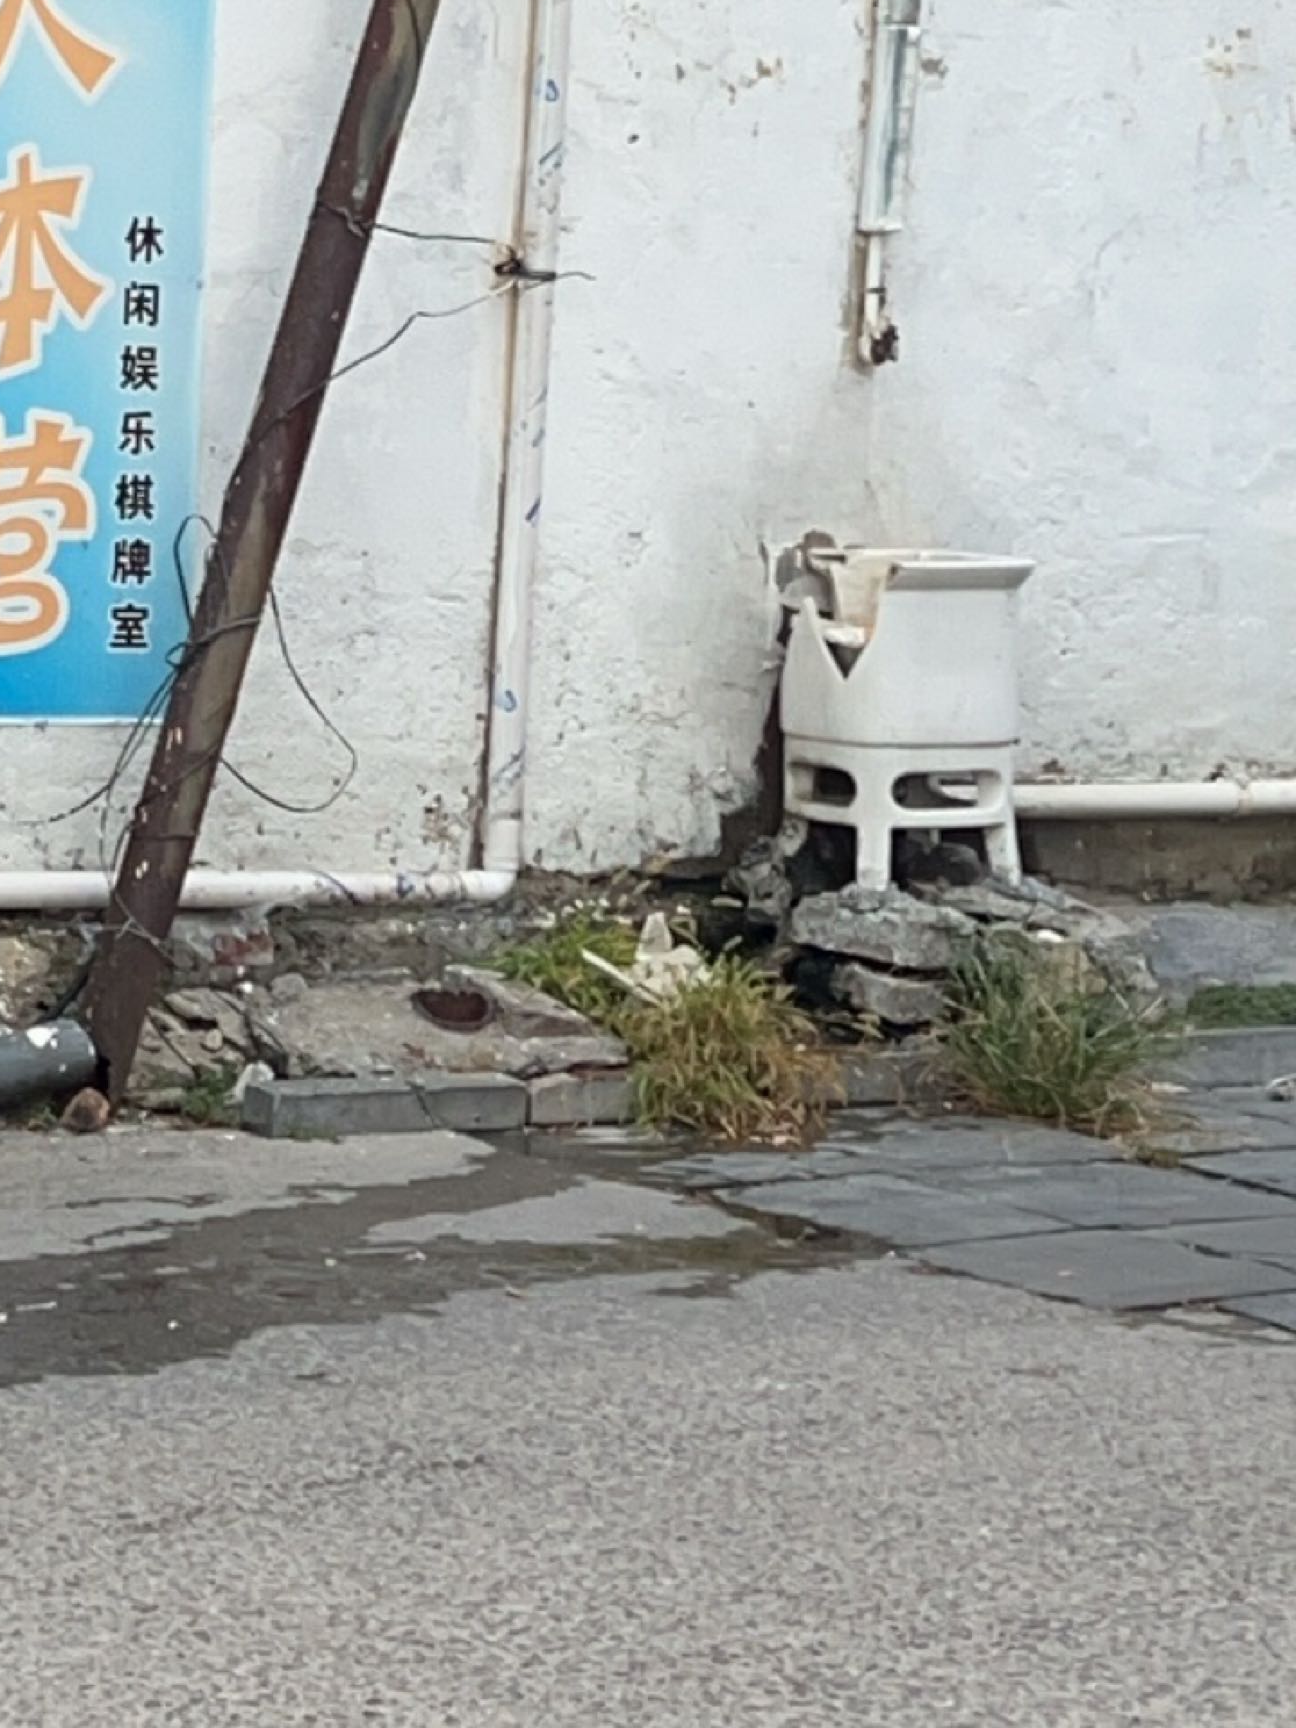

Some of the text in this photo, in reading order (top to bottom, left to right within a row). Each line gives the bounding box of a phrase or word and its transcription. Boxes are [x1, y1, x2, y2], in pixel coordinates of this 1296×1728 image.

[109, 216, 164, 649] 休闲娱乐棋牌室
